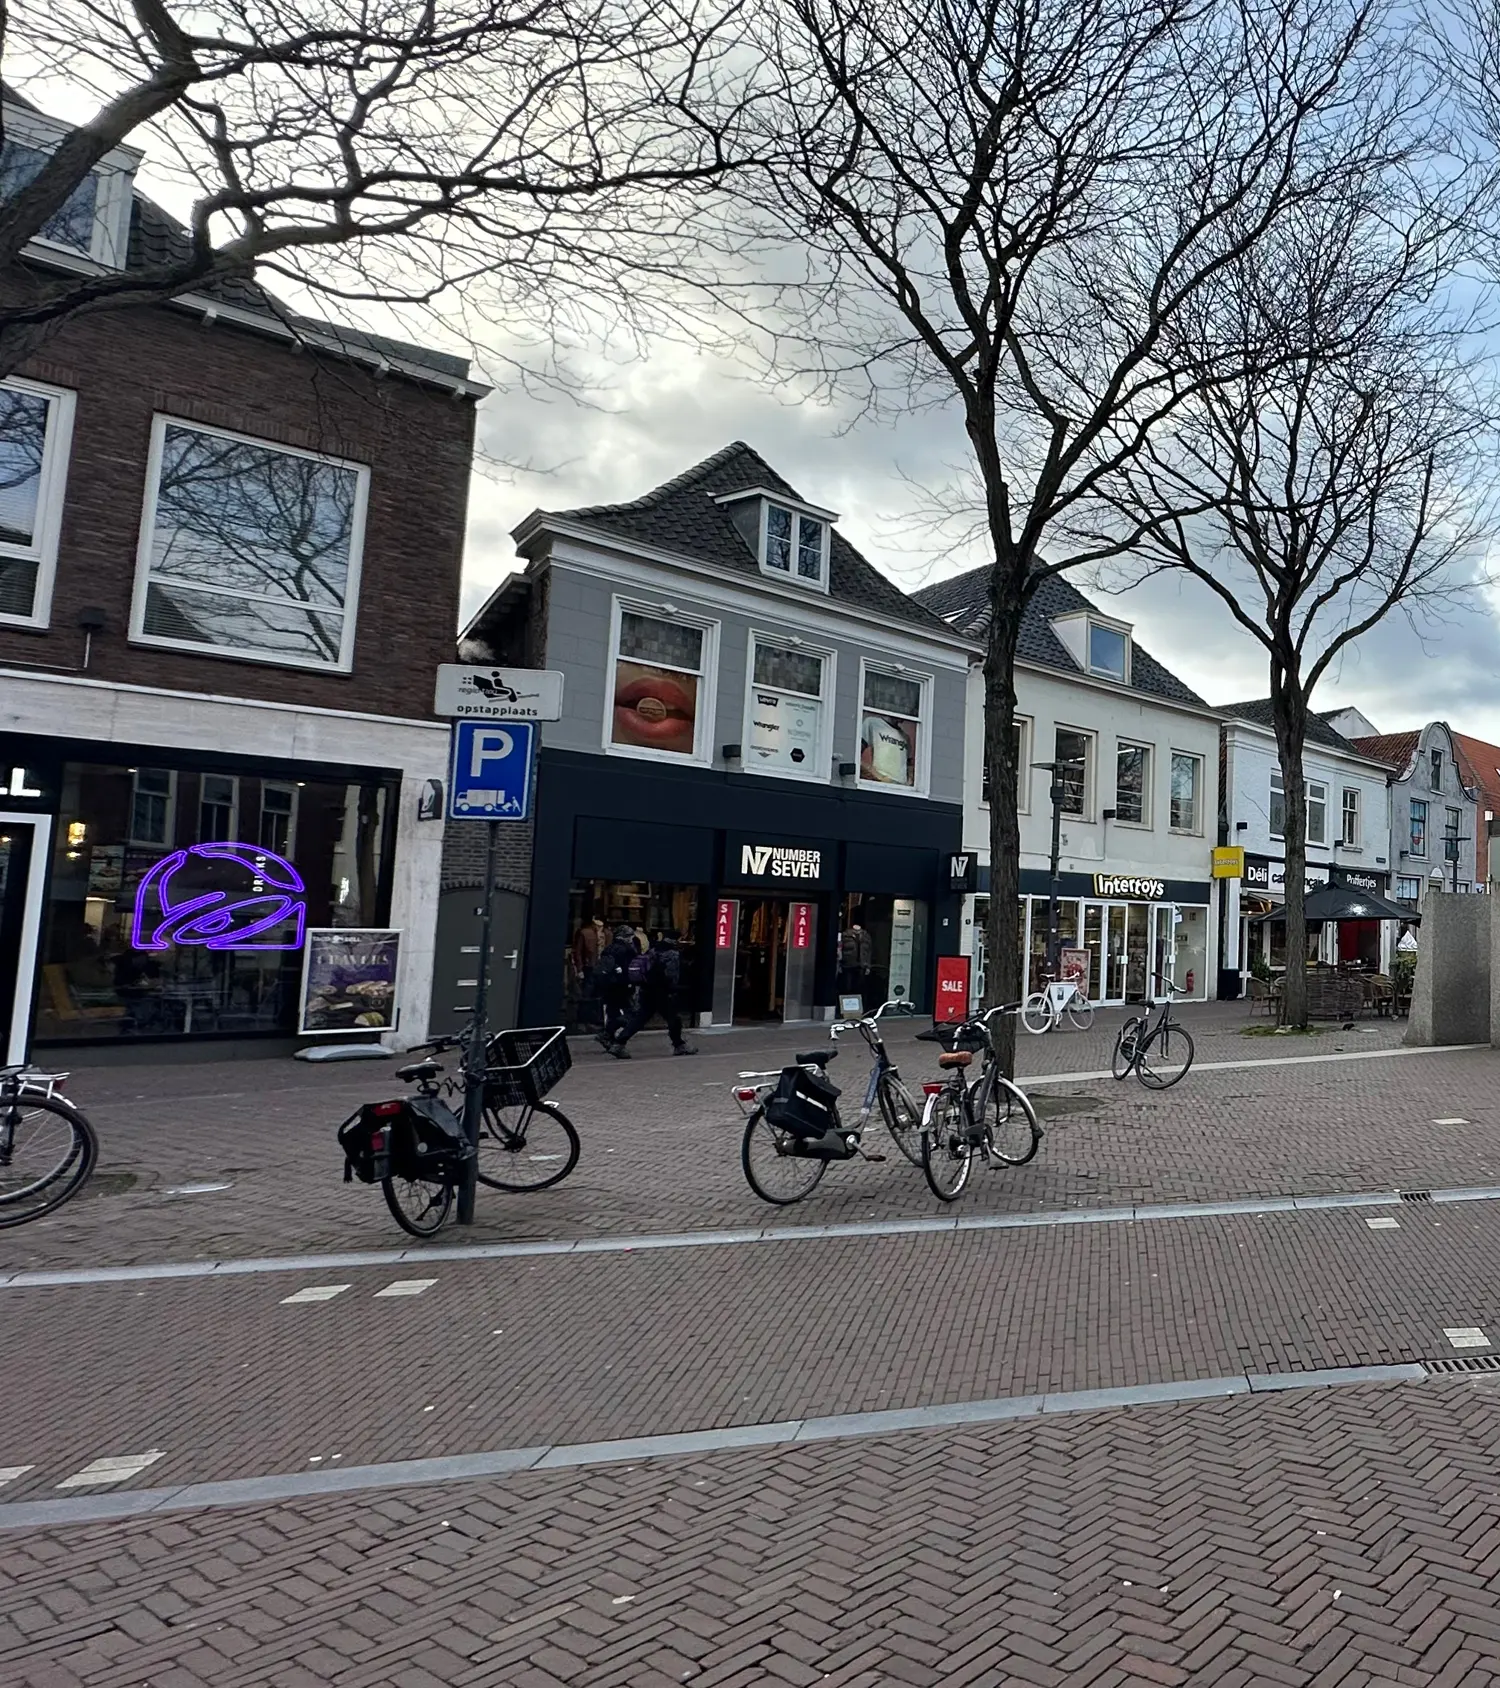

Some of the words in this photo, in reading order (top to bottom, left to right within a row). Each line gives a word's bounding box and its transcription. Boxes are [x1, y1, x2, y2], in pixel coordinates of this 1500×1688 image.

[456, 704, 538, 716] opstapplaats
[470, 728, 514, 777] P
[741, 844, 772, 875] N7
[772, 847, 821, 862] NUMBER
[771, 860, 820, 879] SEVEN
[1098, 873, 1165, 898] Intertoys
[1247, 866, 1268, 883] Déli
[719, 903, 728, 946] SALE
[798, 906, 807, 946] SALE
[942, 980, 963, 992] SALE
